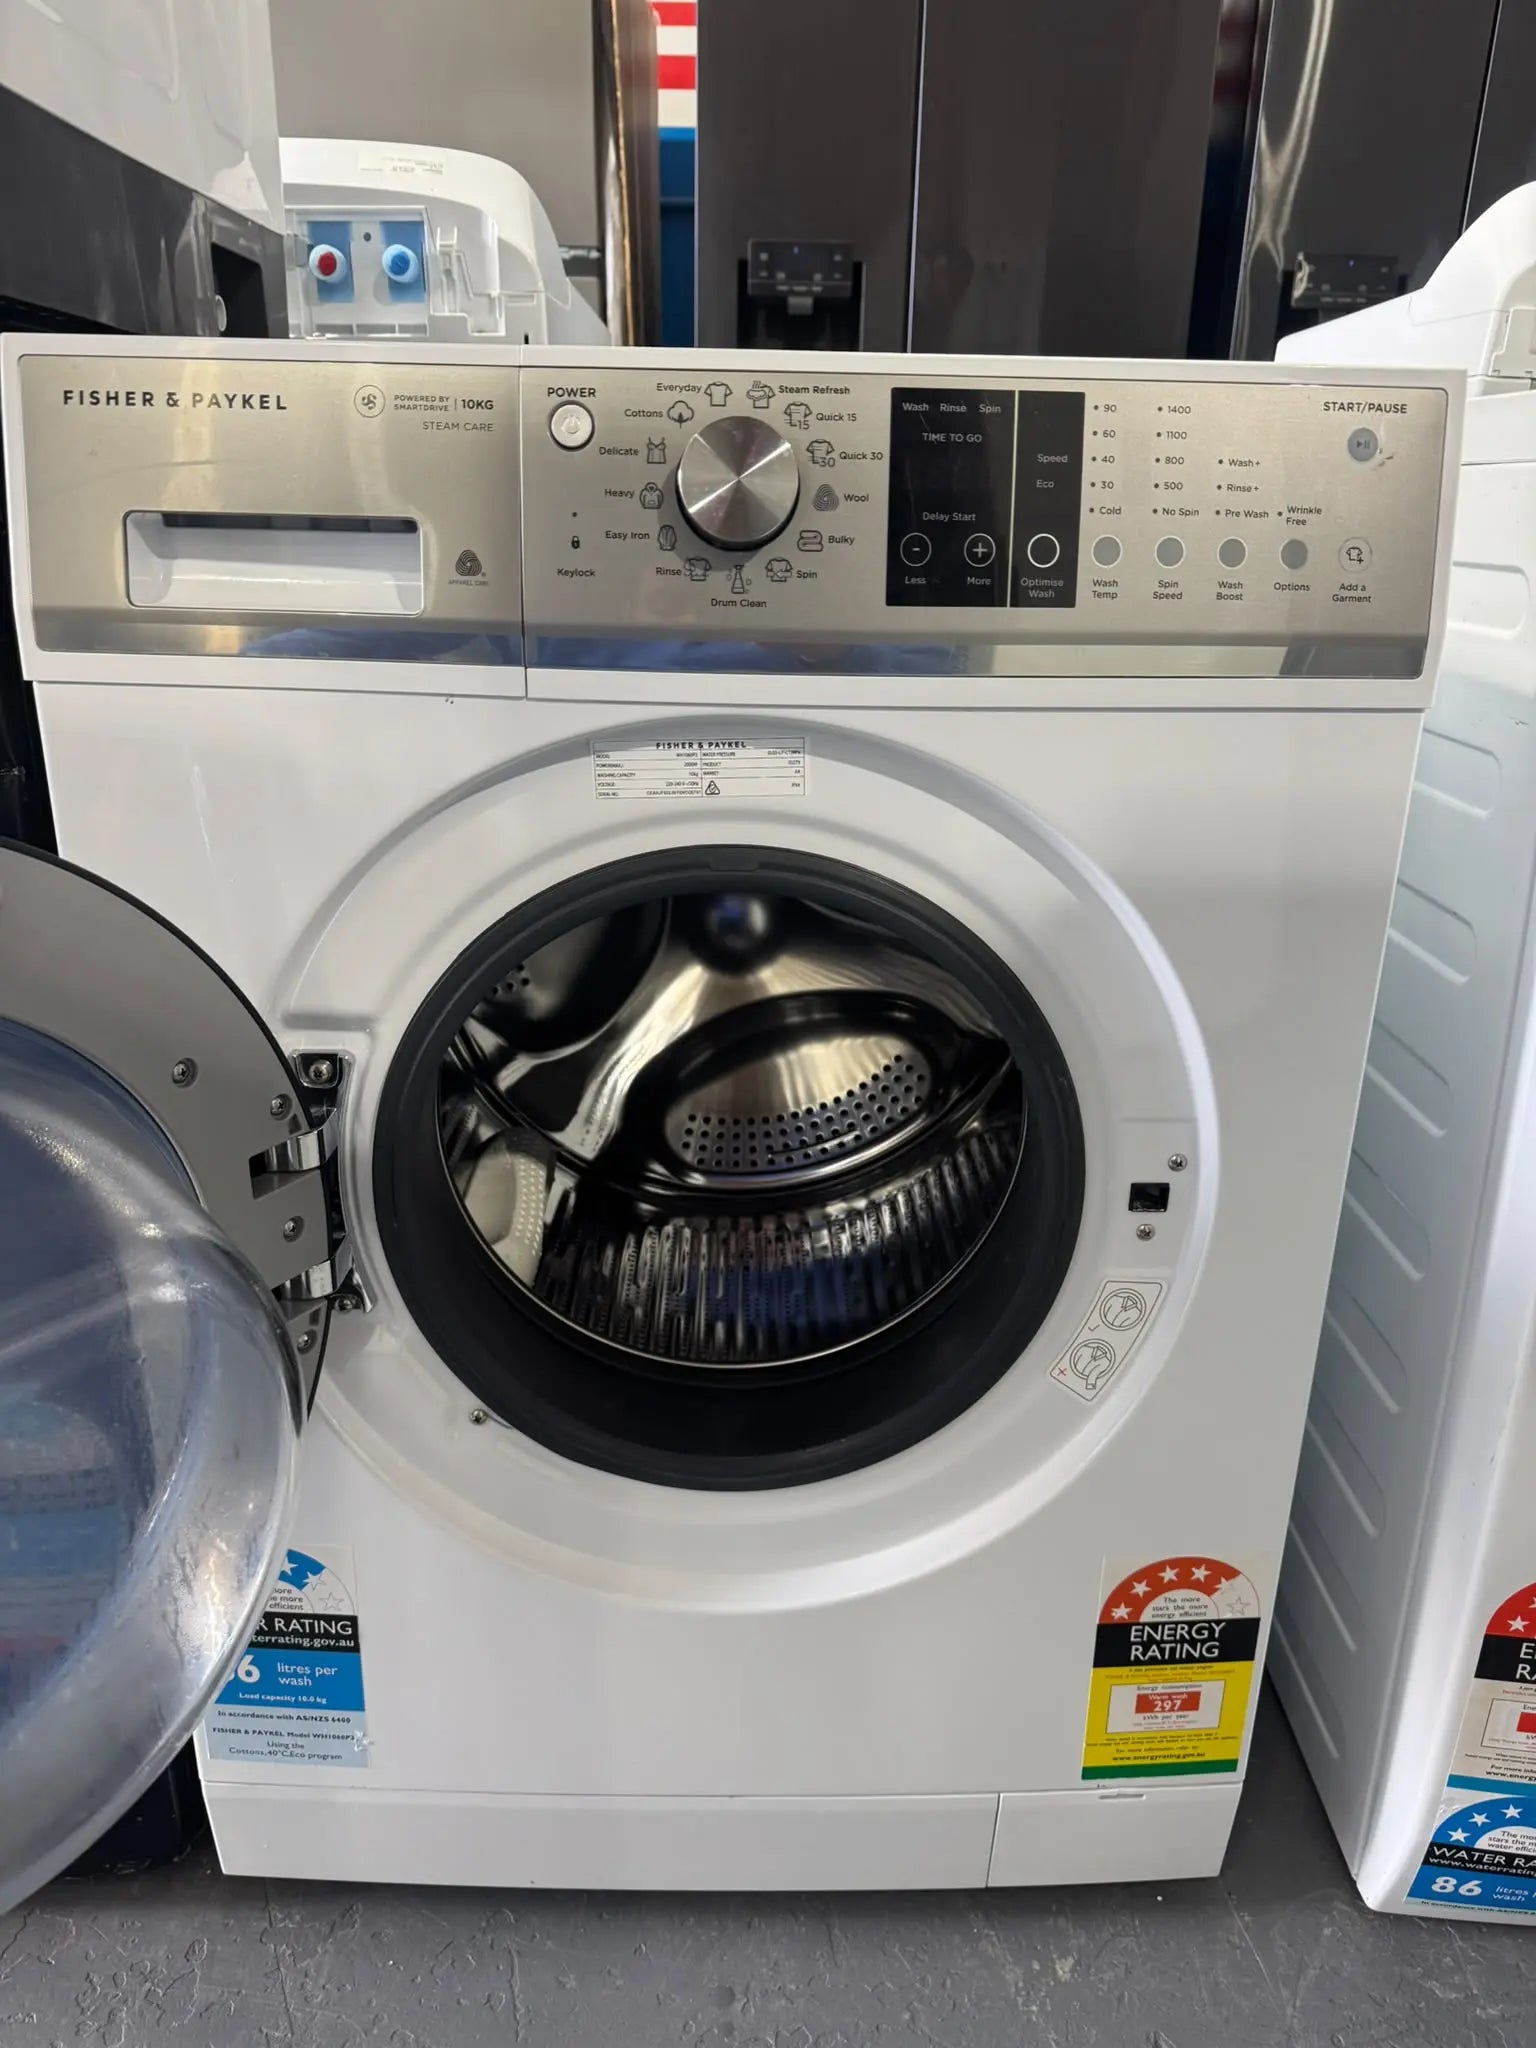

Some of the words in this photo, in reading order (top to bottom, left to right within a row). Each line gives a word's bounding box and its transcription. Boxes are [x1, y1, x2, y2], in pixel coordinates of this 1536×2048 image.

[547, 387, 596, 398] POWER
[656, 383, 702, 395] Everyday
[779, 385, 810, 395] Steam
[812, 386, 850, 396] Refresh
[63, 390, 155, 408] FISHER
[166, 391, 180, 408] &
[191, 393, 288, 411] PAYKEL
[394, 395, 437, 403] POWERED
[394, 404, 449, 412] SMARTDRIVE
[462, 399, 494, 411] 10KG
[902, 403, 929, 412] Wash
[939, 403, 967, 413] Rinse
[979, 404, 1001, 415] Spin
[1103, 404, 1117, 413] 90
[1167, 405, 1191, 415] 1400
[1323, 401, 1408, 415] START/PAUSE
[624, 408, 664, 419] Cottons
[816, 412, 844, 423] Quick
[847, 413, 857, 422] 15
[422, 421, 460, 431] STEAM
[464, 423, 494, 432] CARE
[922, 433, 946, 442] TIME
[949, 433, 964, 443] TO
[966, 434, 983, 443] GO
[1102, 429, 1116, 439] 60
[1166, 430, 1187, 440] 1100
[599, 447, 639, 457] Delicate
[839, 451, 868, 462] Quick
[869, 452, 883, 461] 30
[1037, 454, 1068, 464] Speed
[1101, 455, 1115, 464] 40
[1164, 456, 1184, 466] 800
[1036, 480, 1054, 489] Eco
[1100, 481, 1114, 490] 30
[1163, 481, 1183, 491] 500
[604, 488, 635, 500] Heavy
[843, 493, 870, 502] Wool
[1099, 506, 1122, 516] Cold
[1162, 507, 1176, 516] No
[1178, 508, 1199, 518] Spin
[1225, 509, 1241, 518] Pre
[1243, 509, 1269, 519] Wash
[1286, 505, 1322, 516] Wrinkle
[922, 512, 950, 522] Delay
[952, 512, 976, 521] Start
[1286, 517, 1307, 526] Free
[605, 531, 628, 542] Easy
[630, 531, 650, 540] Iron
[828, 535, 855, 546] Bulky
[557, 567, 596, 579] Keylock
[655, 567, 682, 577] Rinse
[796, 570, 818, 580] Spin
[905, 576, 926, 585] Less
[967, 576, 991, 586] More
[1020, 577, 1064, 588] Optimise
[1092, 578, 1118, 588] Wash
[1157, 579, 1179, 590] Spin
[1217, 580, 1243, 590] Wash
[1273, 582, 1310, 592] Options
[1339, 583, 1357, 592] Add
[1028, 589, 1055, 598] Wash
[1092, 590, 1118, 601] Temp
[1153, 590, 1183, 602] Speed
[1216, 591, 1243, 601] Boost
[711, 598, 738, 608] Drum
[740, 598, 767, 609] Clean
[1332, 594, 1371, 604] Garment
[708, 741, 747, 749] PAYKEL
[274, 1617, 353, 1636] RATING
[1130, 1621, 1227, 1642] ENERGY
[252, 1634, 355, 1648] terrating.gov.au
[1130, 1641, 1220, 1661] RATING
[277, 1662, 311, 1674] litres
[315, 1663, 338, 1677] per
[278, 1675, 312, 1686] wash
[239, 1692, 260, 1700] Load
[262, 1694, 295, 1703] capacity
[316, 1696, 328, 1704] kg
[1153, 1700, 1183, 1712] 297
[228, 1711, 274, 1720] accordance
[331, 1716, 351, 1724] 6400
[252, 1729, 285, 1737] PAYKEL
[287, 1731, 311, 1739] Model
[267, 1740, 290, 1750] Using
[308, 1753, 343, 1761] program
[1500, 1830, 1518, 1838] The
[1488, 1836, 1510, 1844] stars
[1433, 1846, 1506, 1865] WATER
[1432, 1876, 1483, 1896] 86
[1496, 1886, 1529, 1896] litres
[1493, 1894, 1525, 1902] wash
